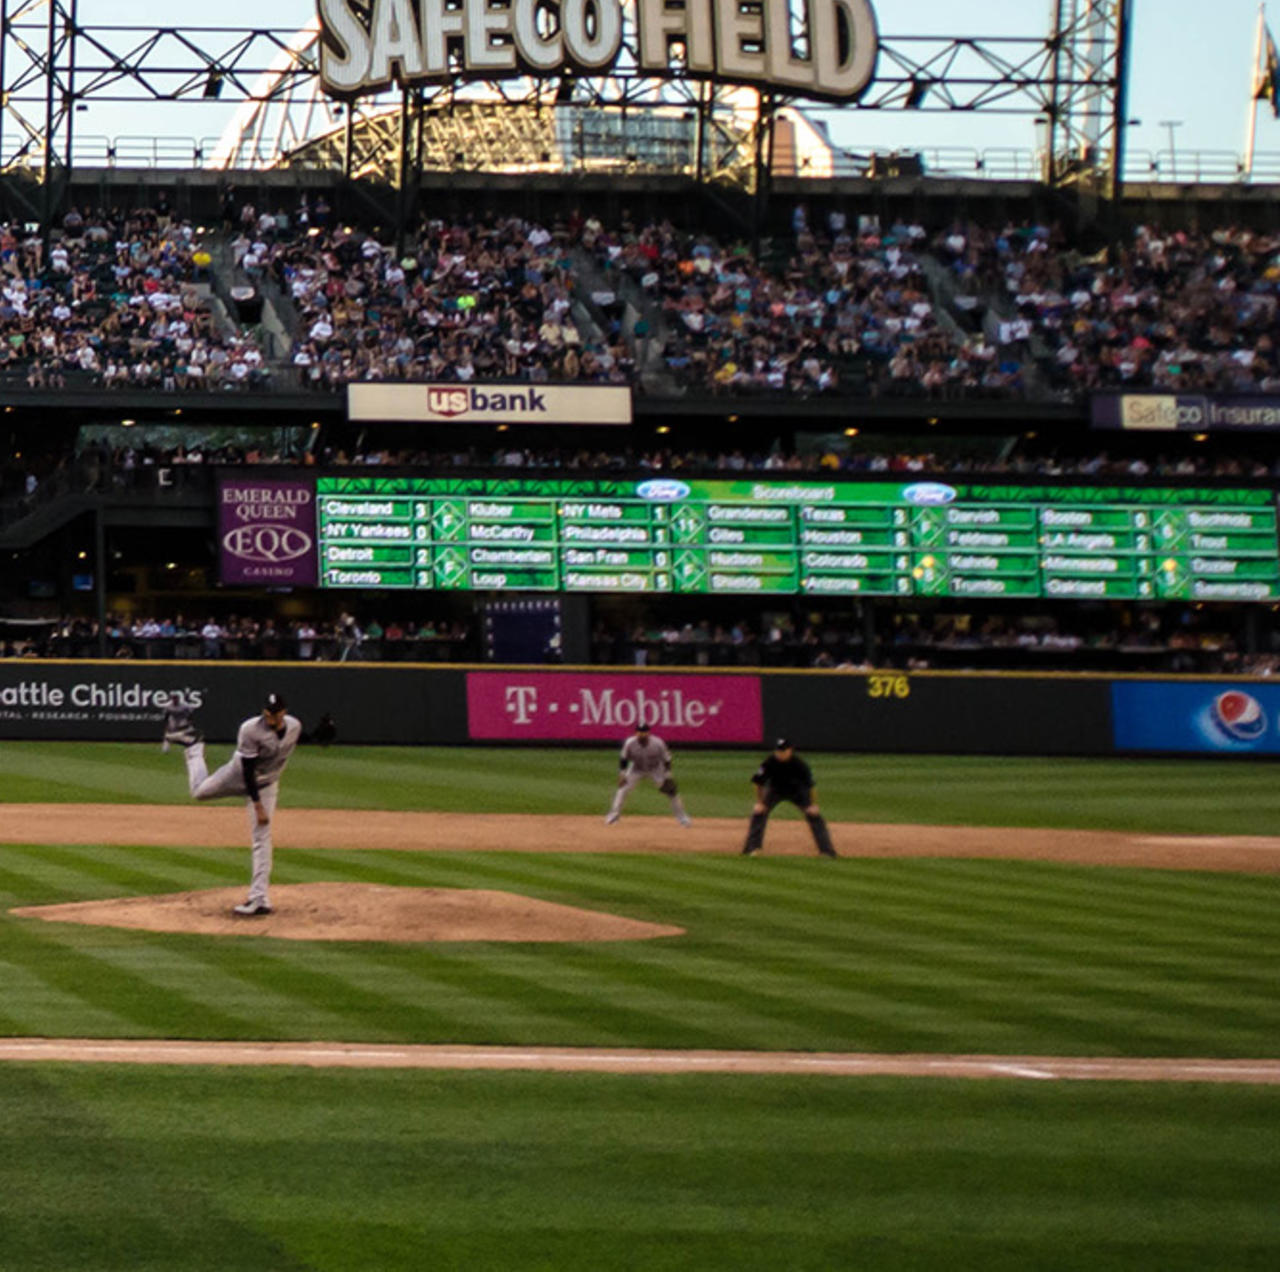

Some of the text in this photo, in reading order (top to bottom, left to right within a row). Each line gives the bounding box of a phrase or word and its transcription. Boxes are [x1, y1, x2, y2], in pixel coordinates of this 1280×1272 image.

[222, 488, 310, 504] EMERALD
[236, 505, 297, 521] QUEEN
[326, 501, 426, 518] Cleveland 3
[470, 502, 514, 517] Kluber
[564, 504, 586, 518] NY
[804, 507, 846, 522] Texas
[326, 525, 427, 539] NY Yankees 0
[470, 525, 534, 542] McCarthy
[564, 526, 648, 542] Philadelphia
[328, 546, 428, 564] Detroit 2
[565, 550, 595, 565] San
[596, 550, 629, 565] Fran
[243, 567, 293, 577] CASINO
[329, 570, 429, 585] Toronto 3
[472, 572, 507, 587] Loup
[566, 573, 619, 587] Kansas
[620, 574, 647, 589] City
[867, 676, 910, 698] 376
[71, 683, 203, 709] Children's
